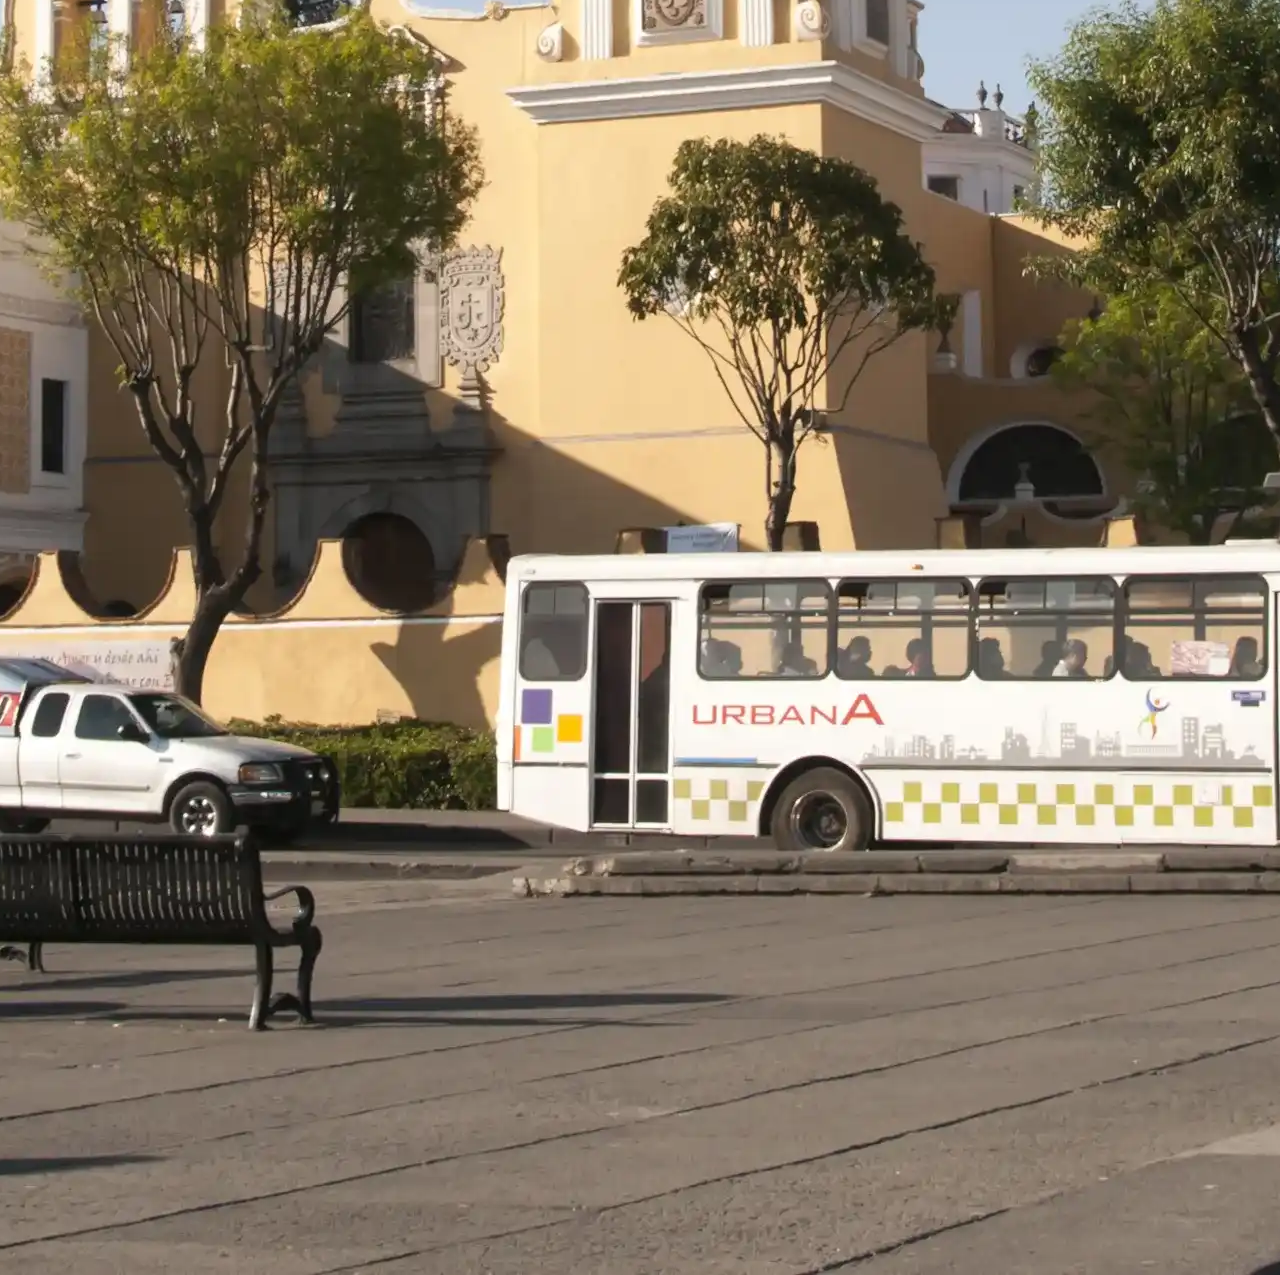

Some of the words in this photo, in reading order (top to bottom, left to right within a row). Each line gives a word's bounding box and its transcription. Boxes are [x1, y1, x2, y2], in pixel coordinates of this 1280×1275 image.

[104, 649, 133, 664] desde
[139, 676, 159, 688] con
[692, 693, 885, 725] URBANA
